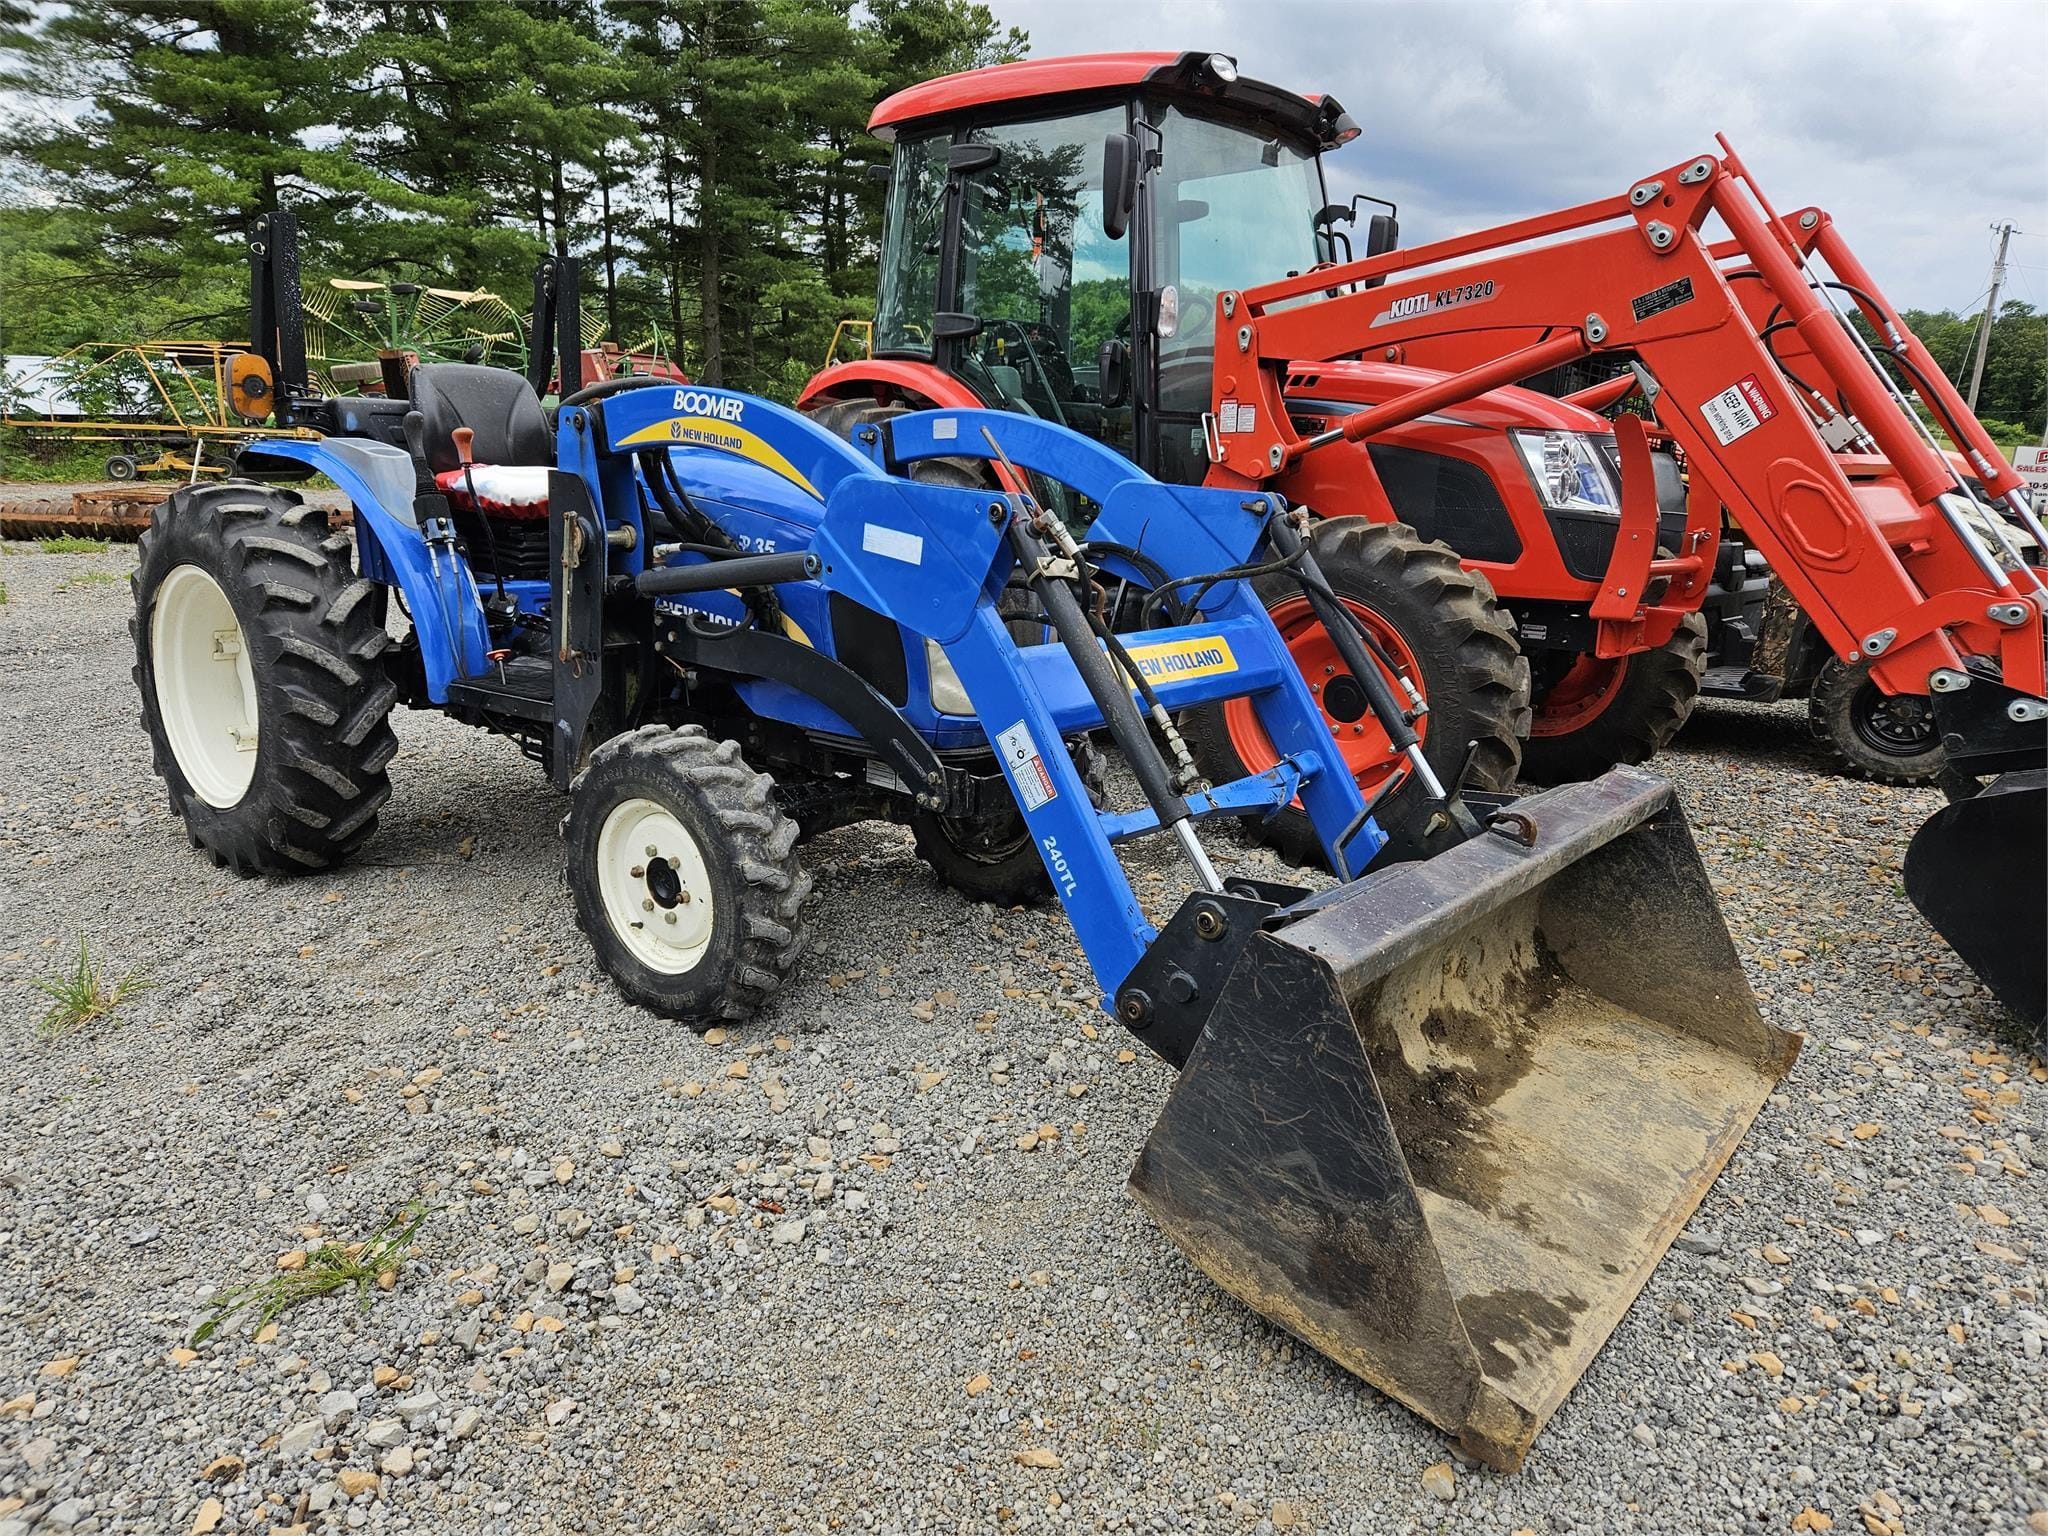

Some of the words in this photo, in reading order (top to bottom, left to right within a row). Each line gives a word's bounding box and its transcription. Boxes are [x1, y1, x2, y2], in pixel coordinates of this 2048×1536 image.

[1389, 293, 1429, 319] KIOTI
[1435, 280, 1494, 307] KL7320
[673, 389, 744, 422] BOOMER
[1721, 390, 1741, 410] KEEP
[1731, 408, 1755, 431] AWAY
[1748, 387, 1773, 419] WARNING
[1713, 410, 1729, 432] working
[683, 427, 702, 441] NEW
[703, 431, 742, 449] HOLLAND
[2016, 464, 2047, 473] SALES
[1137, 658, 1161, 676] EW
[1162, 649, 1223, 672] HOLLAND
[1038, 766, 1054, 797] DANGER
[1043, 835, 1078, 897] 240TL
